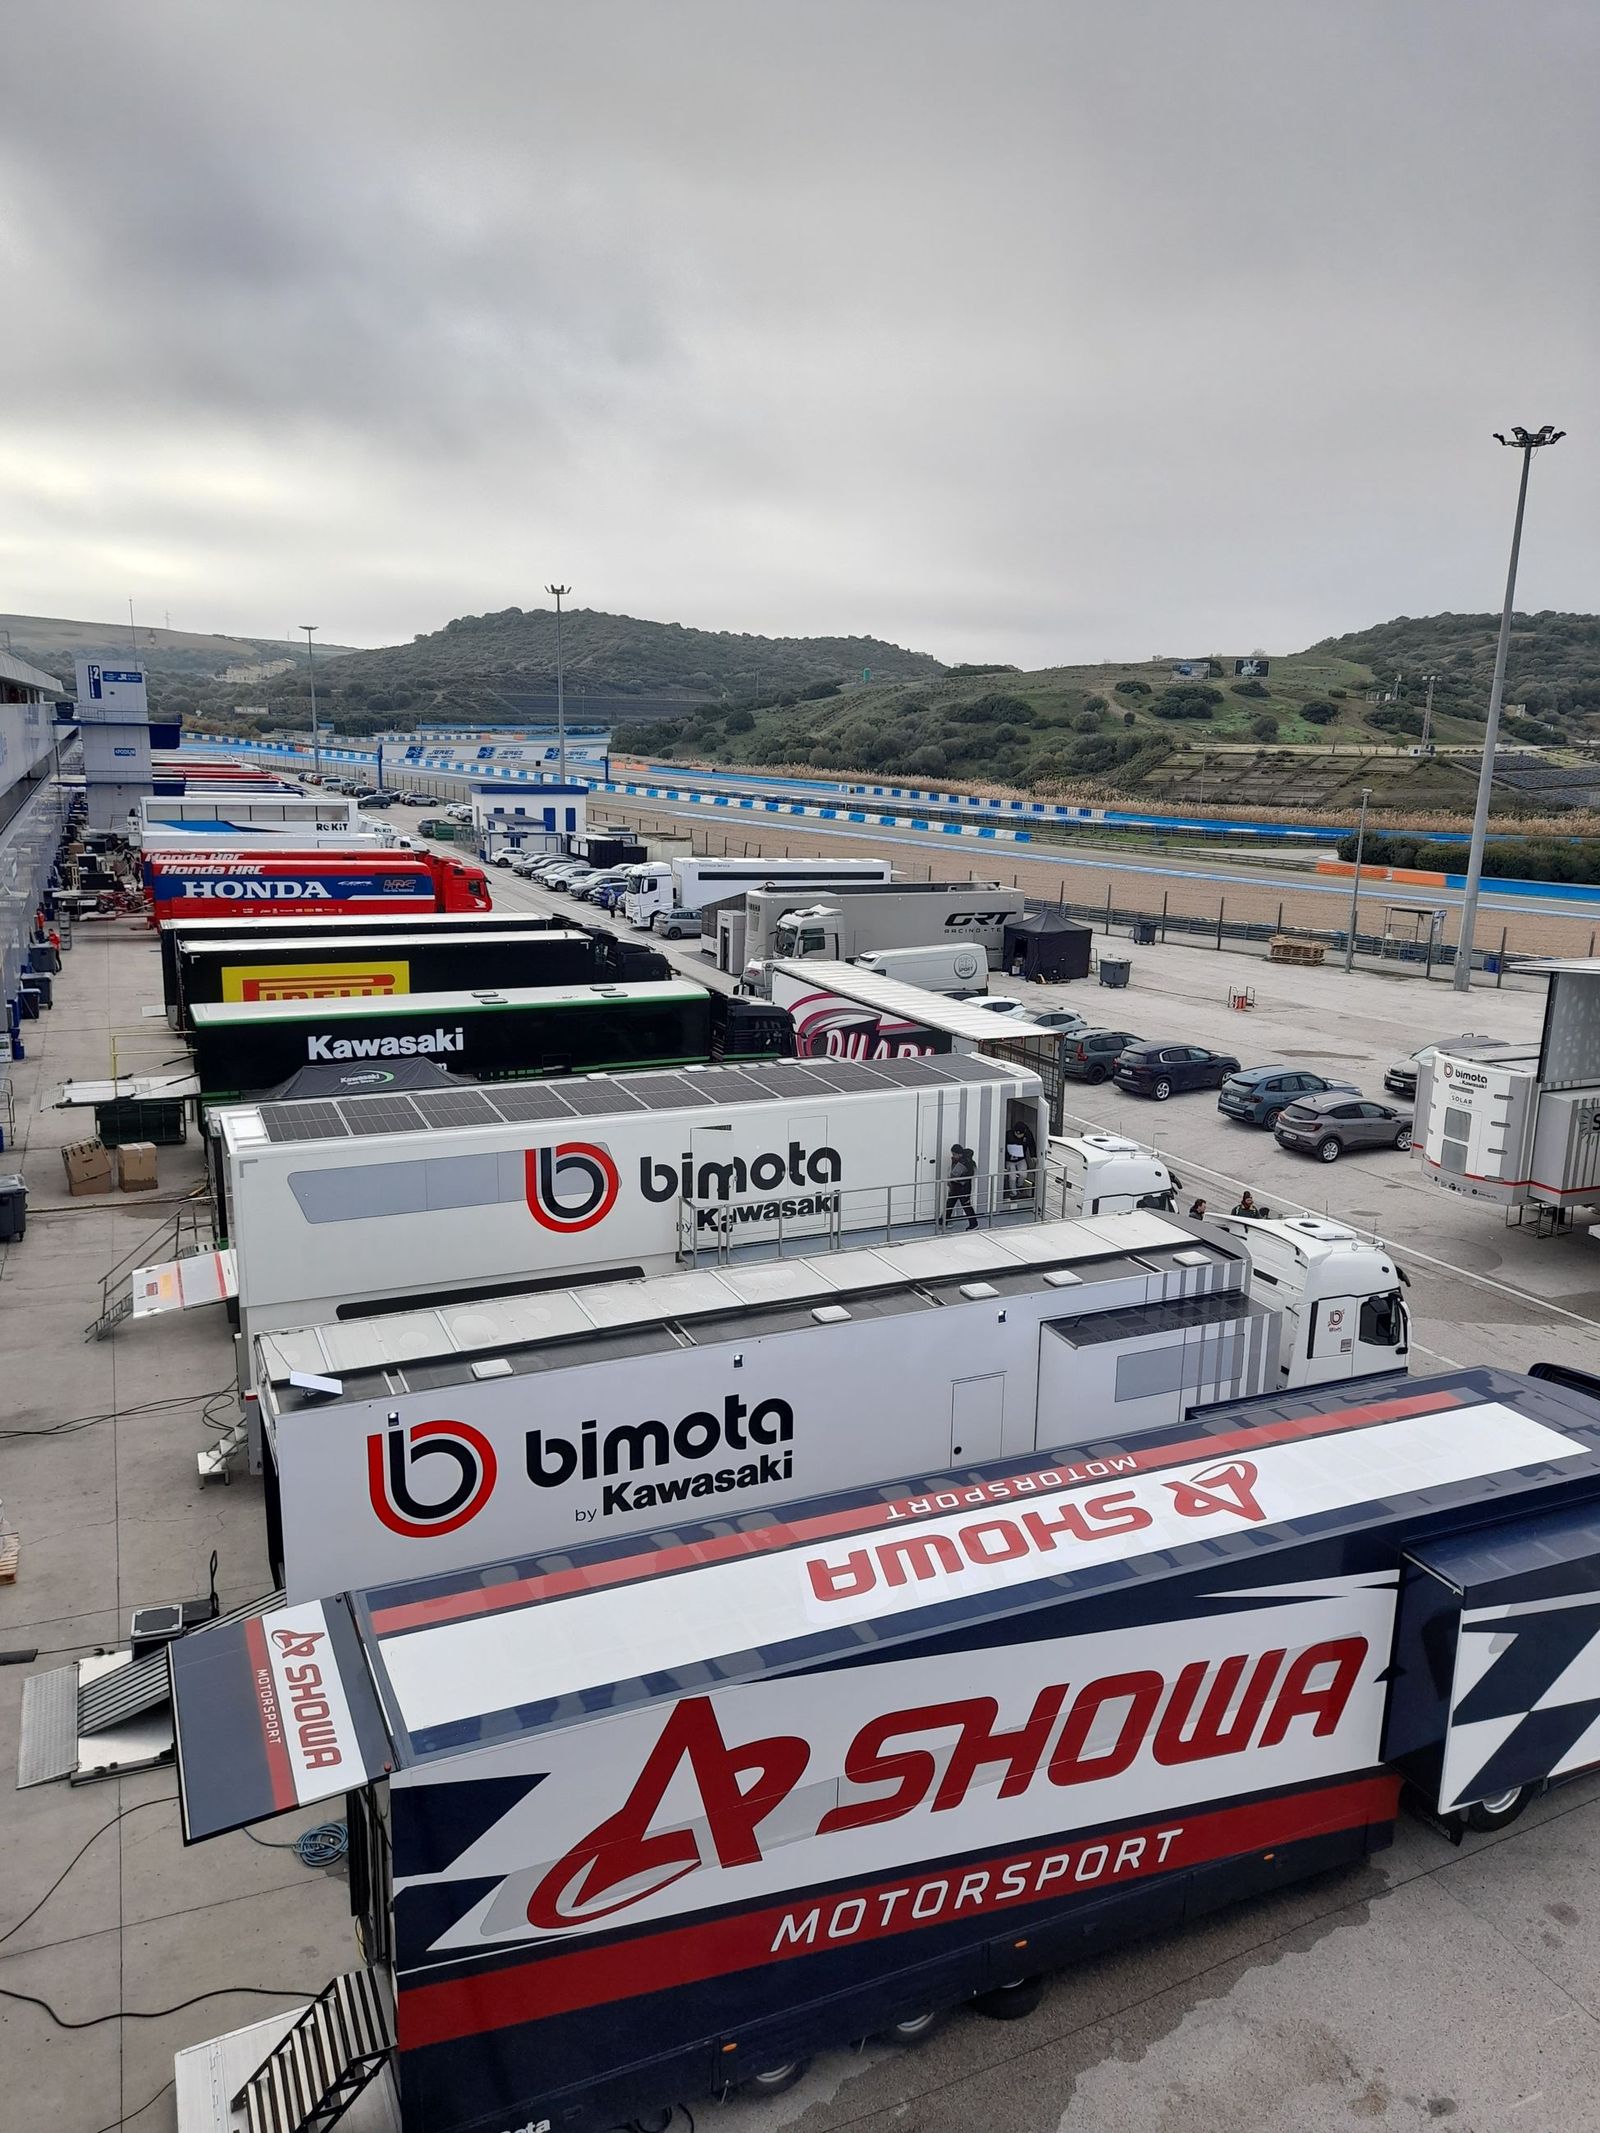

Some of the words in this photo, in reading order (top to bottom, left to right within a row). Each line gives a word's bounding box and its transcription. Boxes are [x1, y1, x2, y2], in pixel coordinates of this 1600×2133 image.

[93, 666, 100, 680] 2
[145, 853, 206, 862] Honda
[161, 865, 225, 874] Honda
[227, 865, 265, 874] HRC
[182, 881, 332, 898] HONDA
[945, 911, 1017, 926] GRT
[308, 1027, 464, 1060] Kawasaki
[1451, 1095, 1473, 1105] SOLAR
[1455, 1069, 1488, 1084] bimota
[640, 1141, 841, 1203] bimota
[697, 1190, 841, 1233] Kawasaki
[526, 1394, 794, 1488] bimota
[575, 1507, 598, 1523] by
[603, 1450, 794, 1516] Kawasaki
[886, 1456, 1138, 1520] MOTORSPORT
[806, 1490, 1153, 1602] SHOWA
[256, 1668, 282, 1744] MOTORSPORT
[285, 1663, 342, 1769] SHOWA
[815, 1637, 1368, 1835] SHOWA
[771, 1828, 1183, 1952] MOTORSPORT
